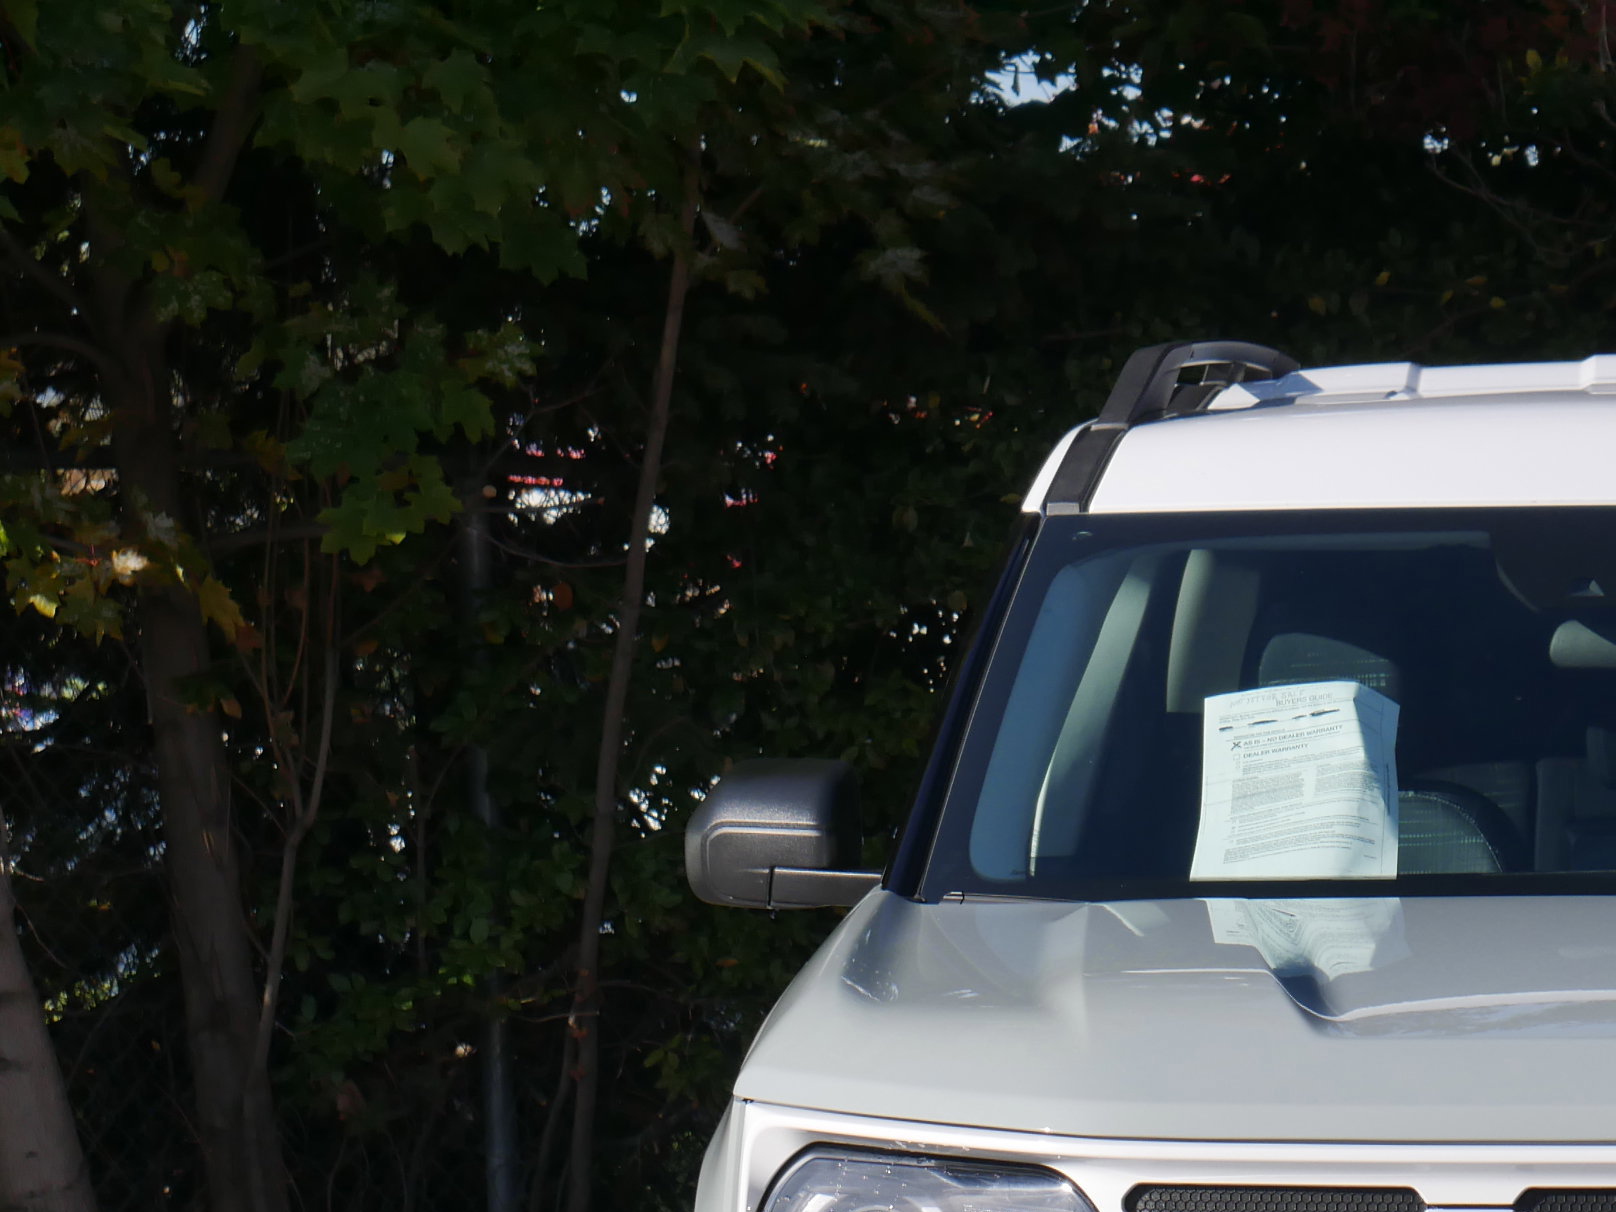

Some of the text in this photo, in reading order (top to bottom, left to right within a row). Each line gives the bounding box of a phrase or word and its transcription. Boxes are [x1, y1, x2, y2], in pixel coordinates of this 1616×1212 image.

[1278, 731, 1305, 741] DEALER
[1306, 724, 1343, 736] WARRANTY
[1243, 743, 1309, 759] DEALER WARRANTY
